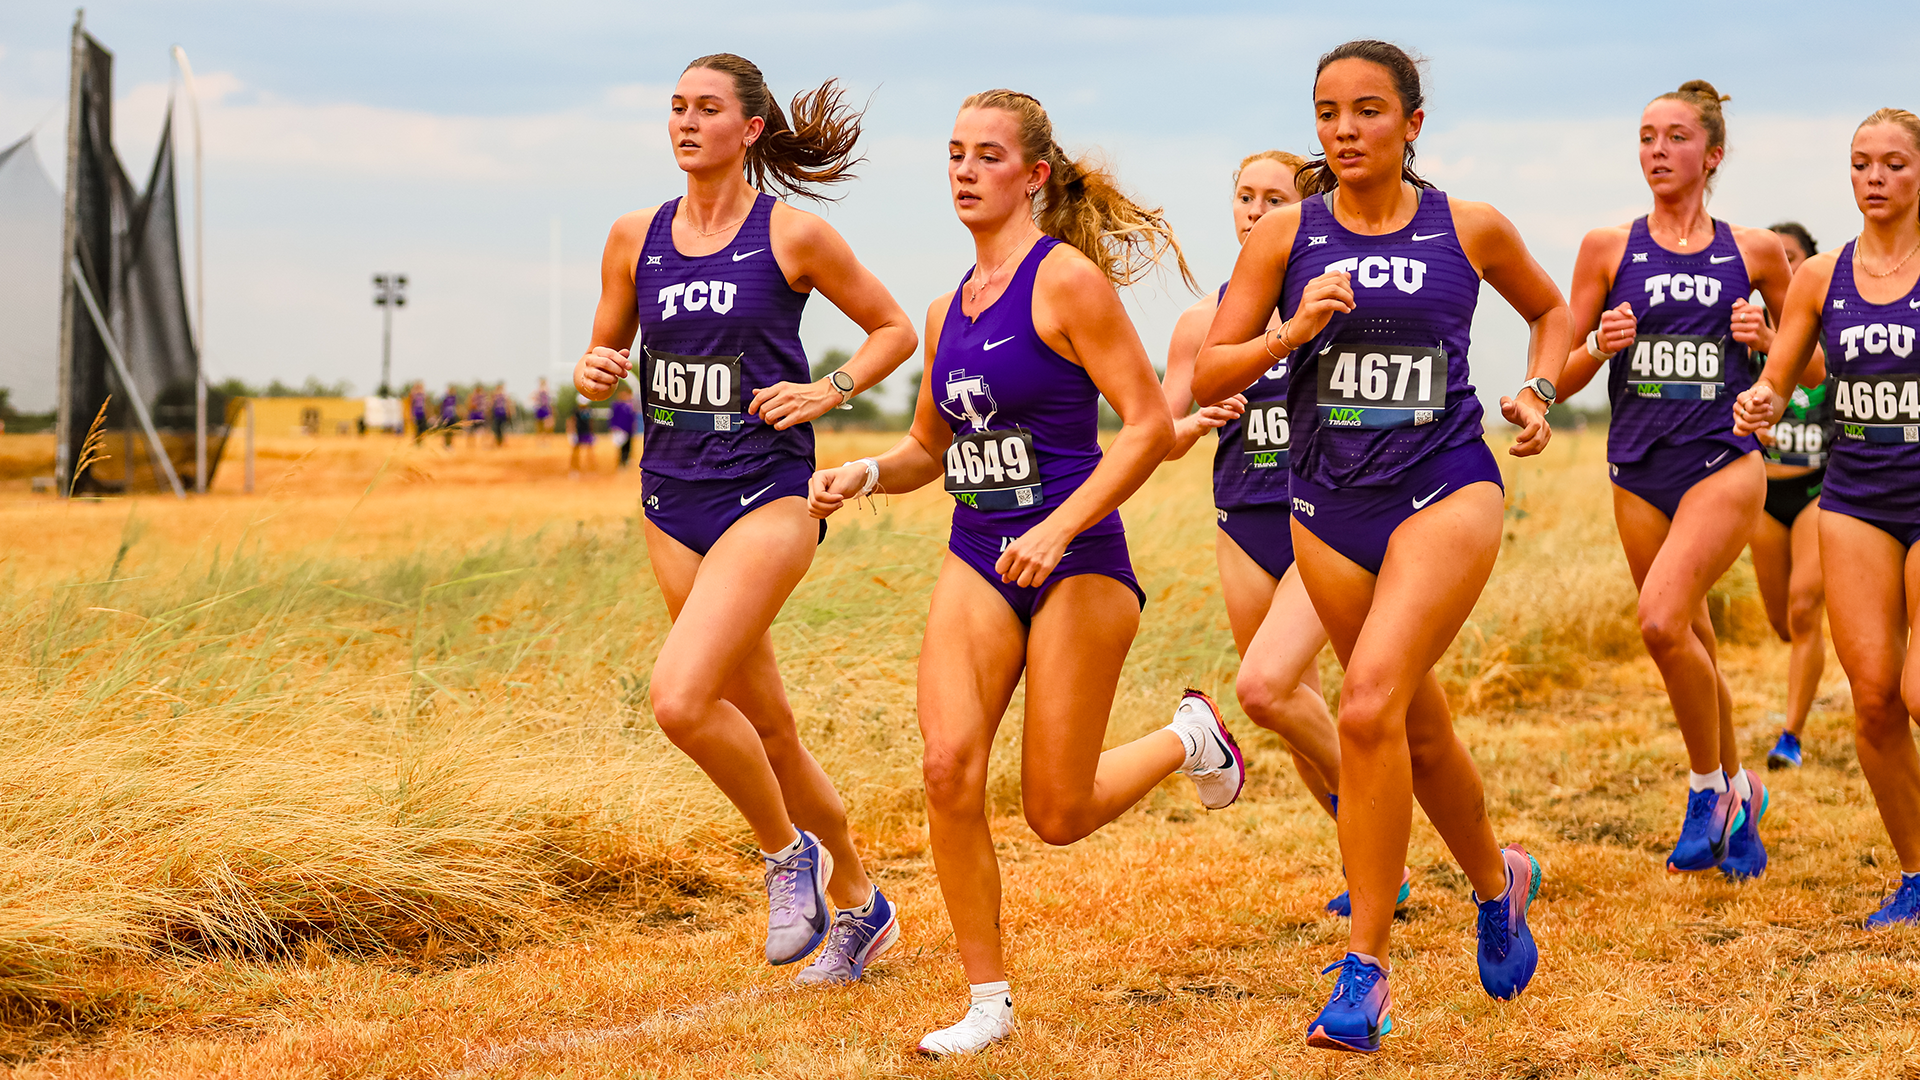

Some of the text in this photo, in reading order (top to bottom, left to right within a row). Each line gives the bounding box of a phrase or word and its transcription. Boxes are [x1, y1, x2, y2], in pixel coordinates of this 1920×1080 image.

[657, 280, 738, 321] TCU
[1644, 273, 1722, 307] TCU
[1631, 341, 1719, 379] 4666
[1839, 323, 1916, 362] TCU
[652, 359, 732, 407] 4670
[1329, 352, 1433, 402] 4671
[1637, 383, 1663, 393] NTX
[654, 408, 675, 422] NTX
[1329, 408, 1364, 421] NTX
[1835, 380, 1920, 421] 4664
[1247, 406, 1290, 446] 46
[1328, 419, 1362, 427] TIMING
[1844, 424, 1865, 436] NTX
[946, 436, 1031, 484] 4649
[1254, 452, 1278, 463] NTX
[1293, 497, 1315, 517] TCU
